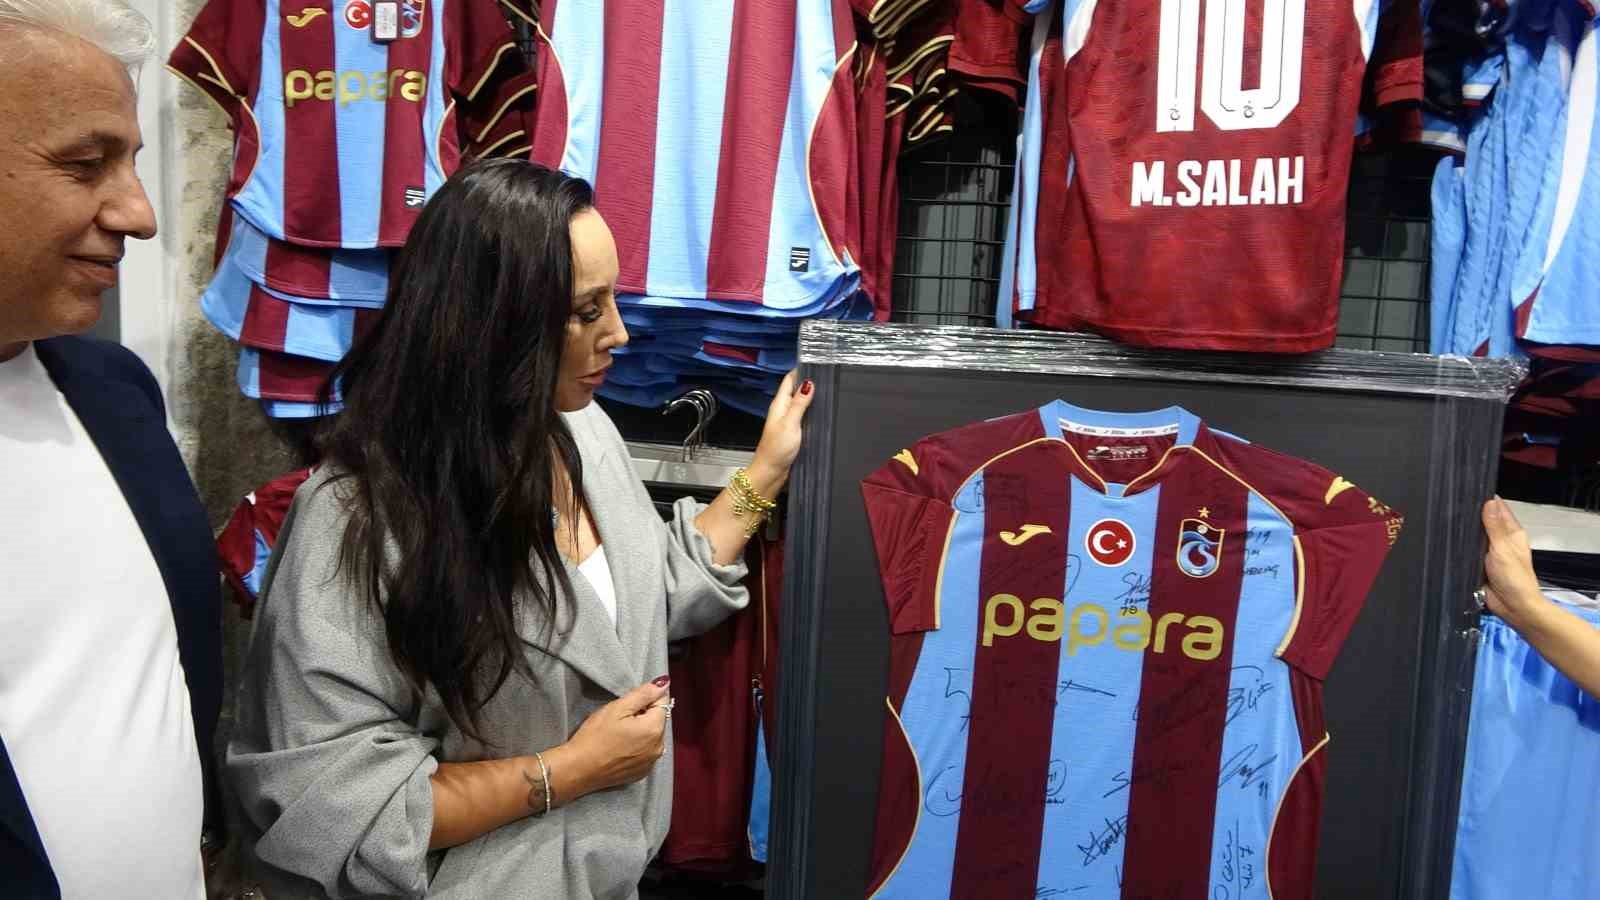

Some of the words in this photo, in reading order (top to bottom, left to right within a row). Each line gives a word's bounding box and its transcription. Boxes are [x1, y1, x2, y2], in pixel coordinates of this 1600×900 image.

[285, 69, 427, 108] papara
[1131, 156, 1304, 207] M.SALAH
[982, 593, 1224, 661] papara
